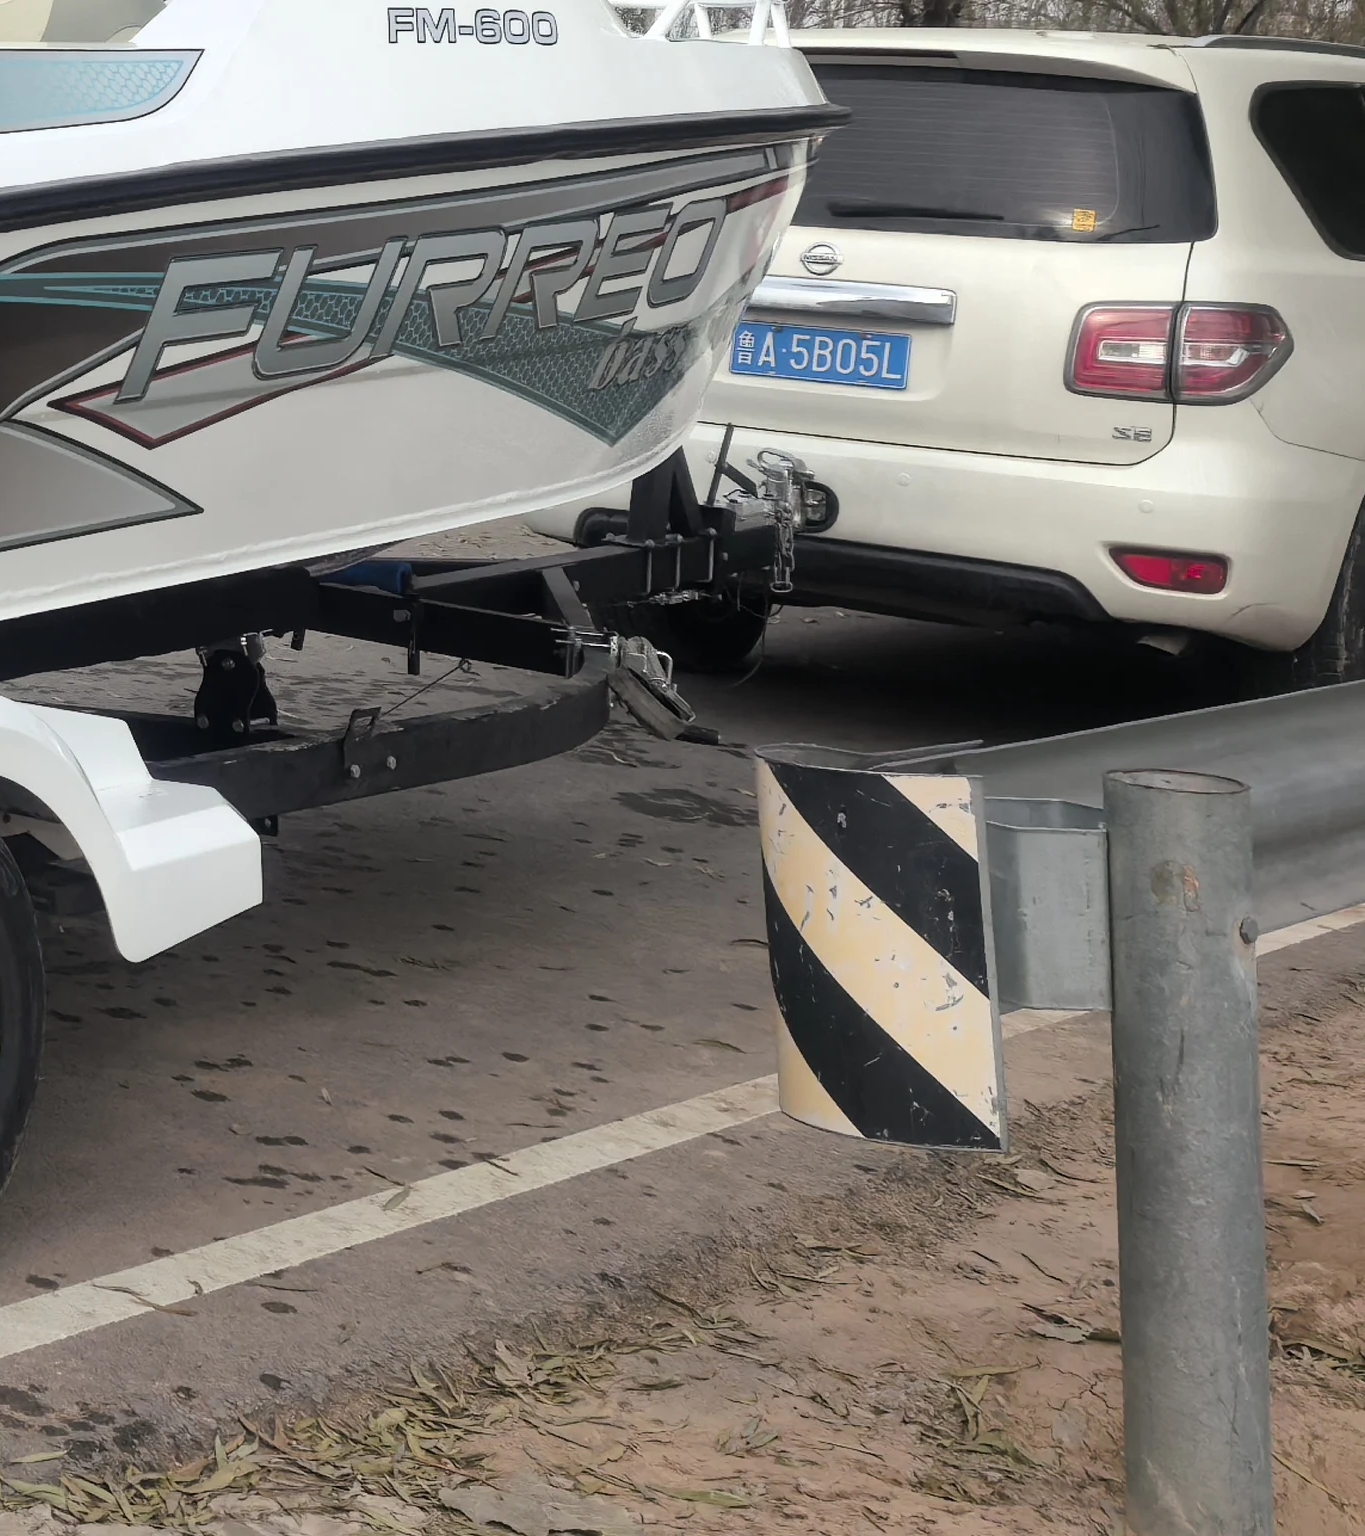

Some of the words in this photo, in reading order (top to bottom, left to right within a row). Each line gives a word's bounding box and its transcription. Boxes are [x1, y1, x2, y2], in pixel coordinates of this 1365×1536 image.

[387, 7, 559, 46] FM-600
[113, 197, 729, 406] FURREO
[1112, 426, 1153, 443] SE
